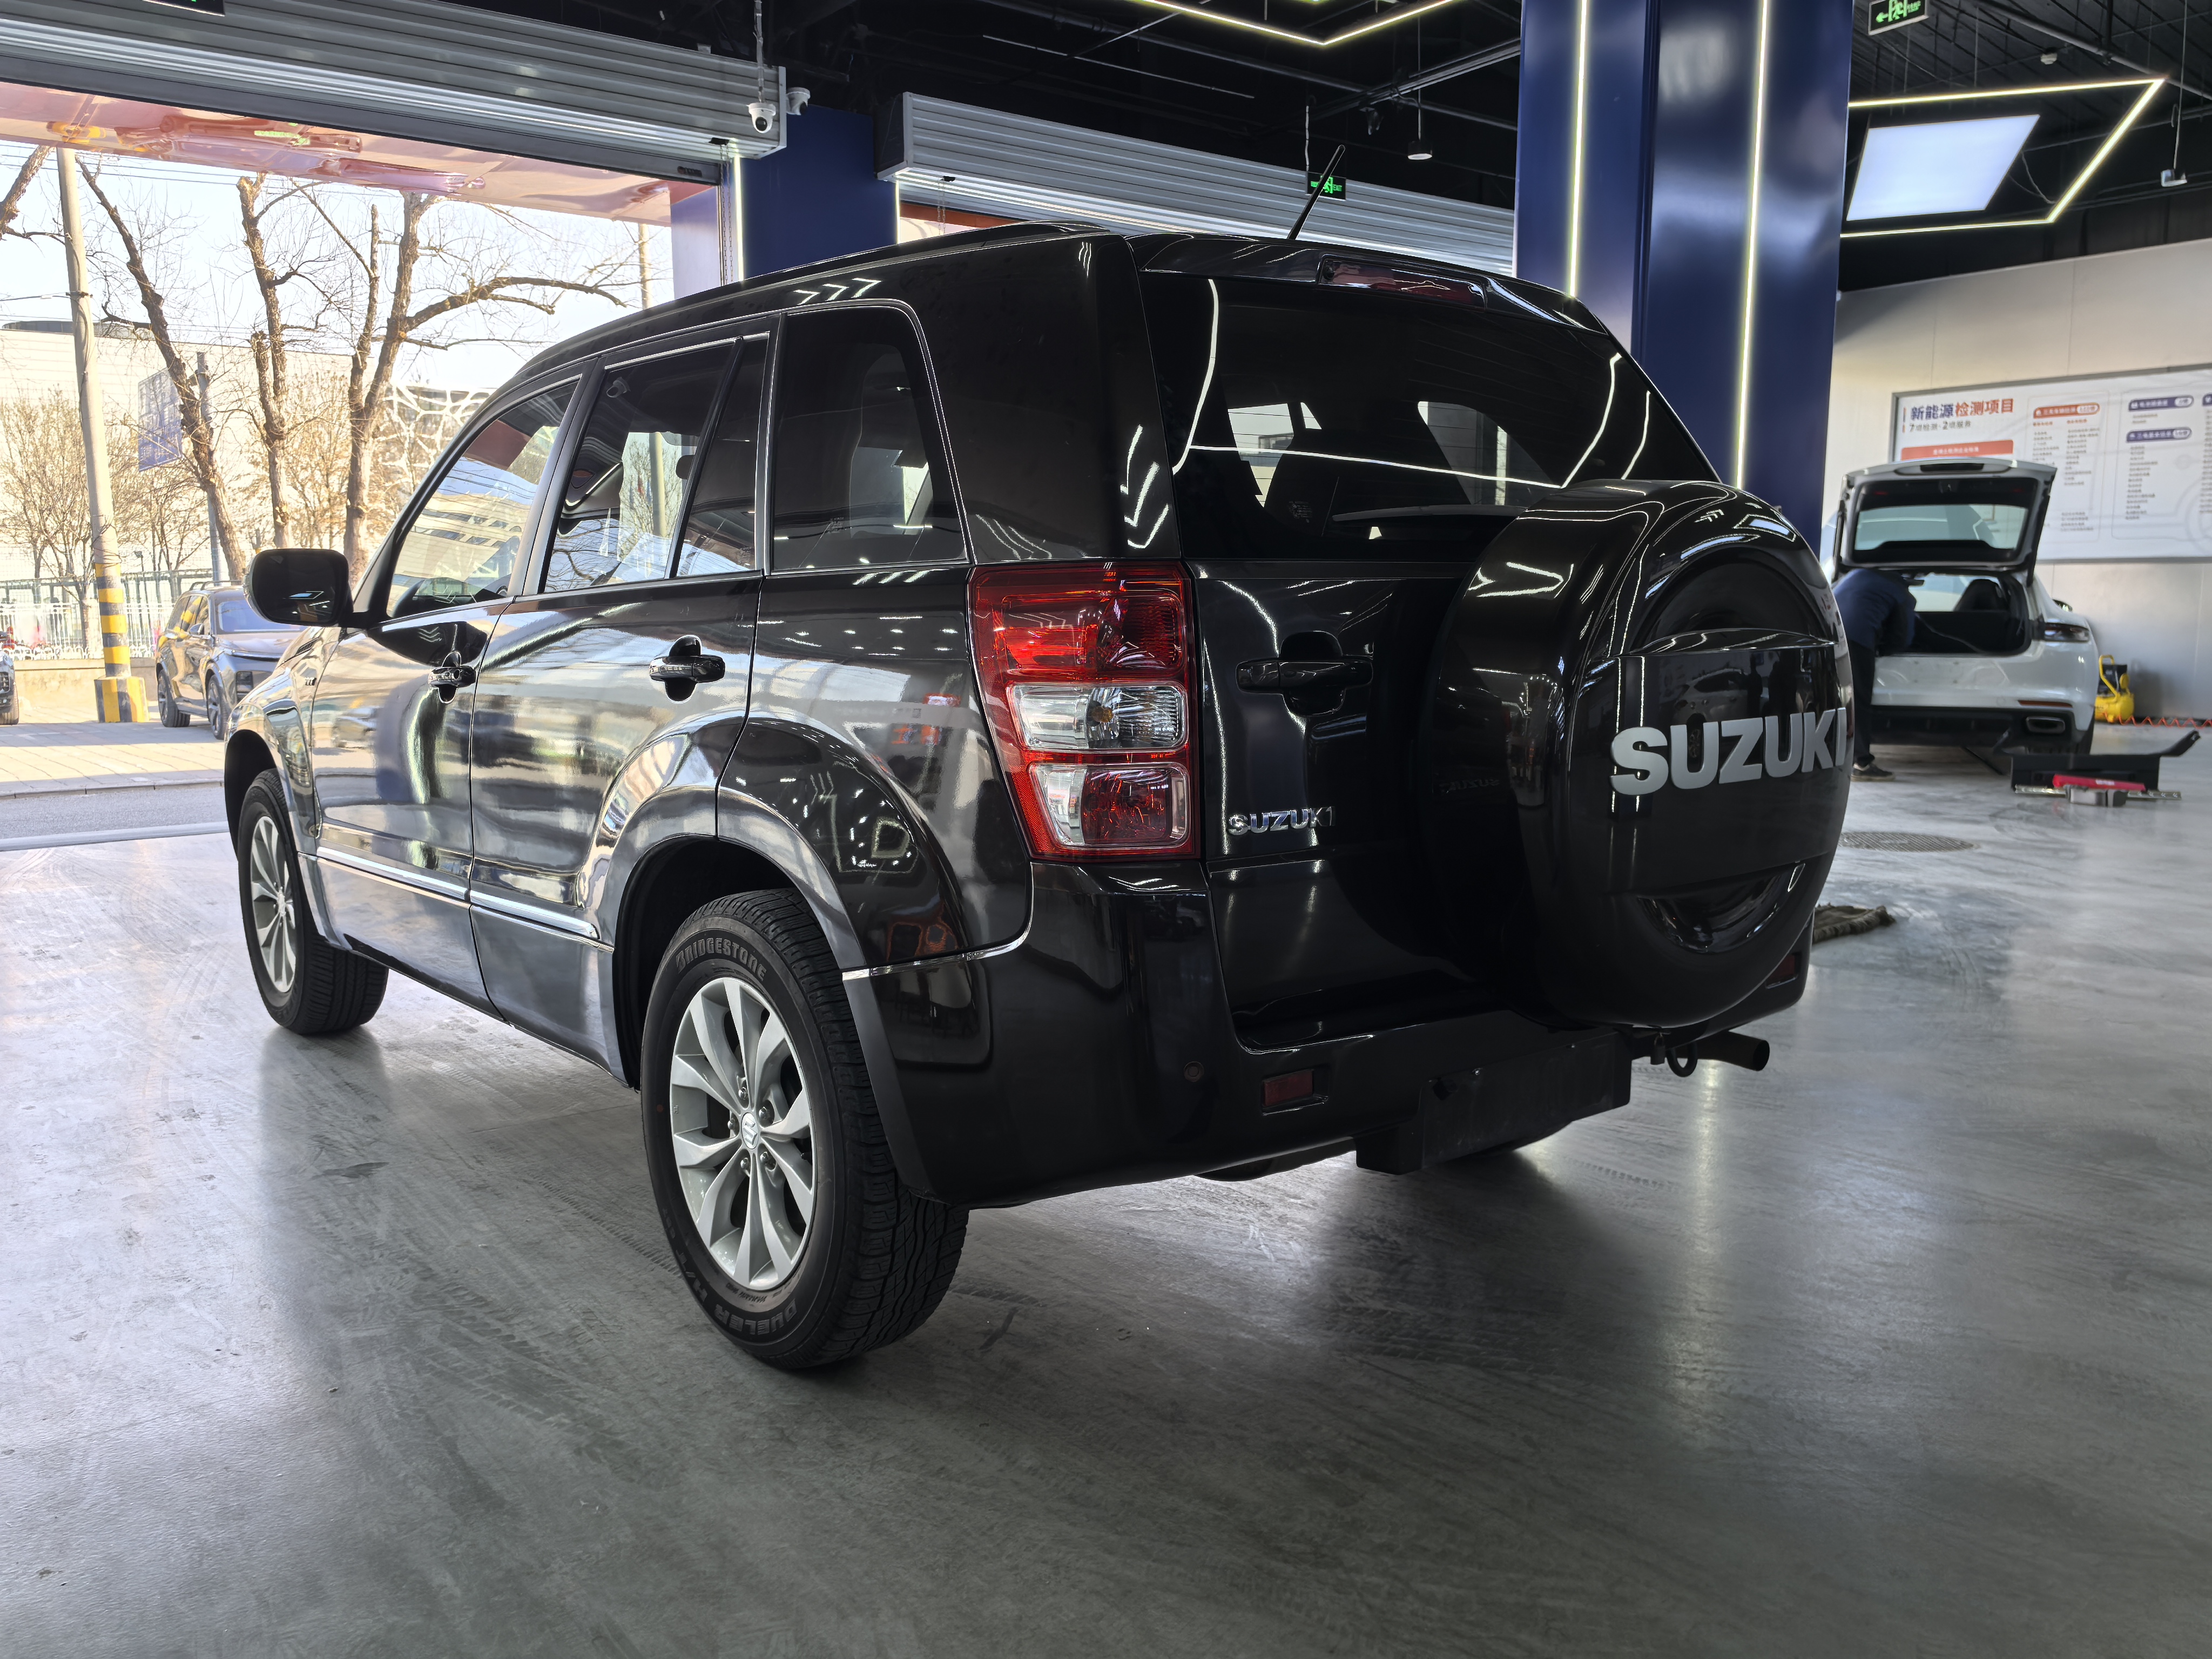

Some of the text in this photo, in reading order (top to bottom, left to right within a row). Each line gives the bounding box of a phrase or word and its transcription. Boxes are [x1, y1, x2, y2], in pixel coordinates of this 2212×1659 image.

[1910, 398, 2014, 421] 新能源检测项目
[1609, 707, 1847, 795] SUZUKI
[1229, 806, 1336, 835] SUZUKI
[676, 938, 767, 982] BRIDGESTONE
[714, 1298, 798, 1336] DUELER
